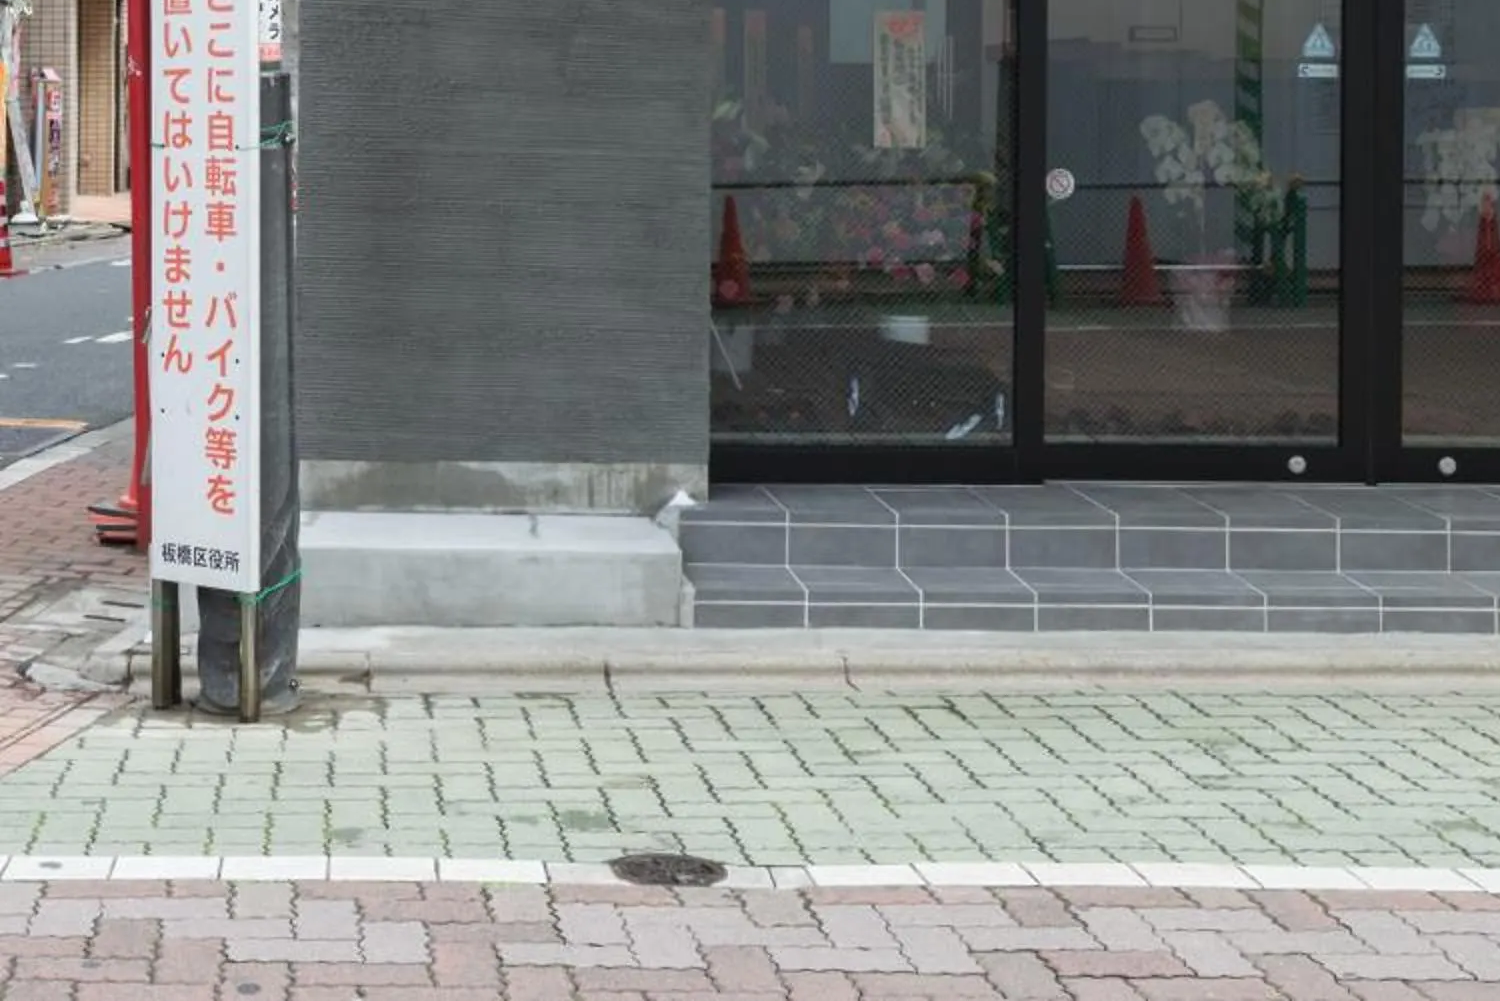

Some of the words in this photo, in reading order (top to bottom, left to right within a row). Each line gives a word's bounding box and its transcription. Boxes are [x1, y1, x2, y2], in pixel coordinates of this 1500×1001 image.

[161, 542, 240, 573] 板橋区役所
